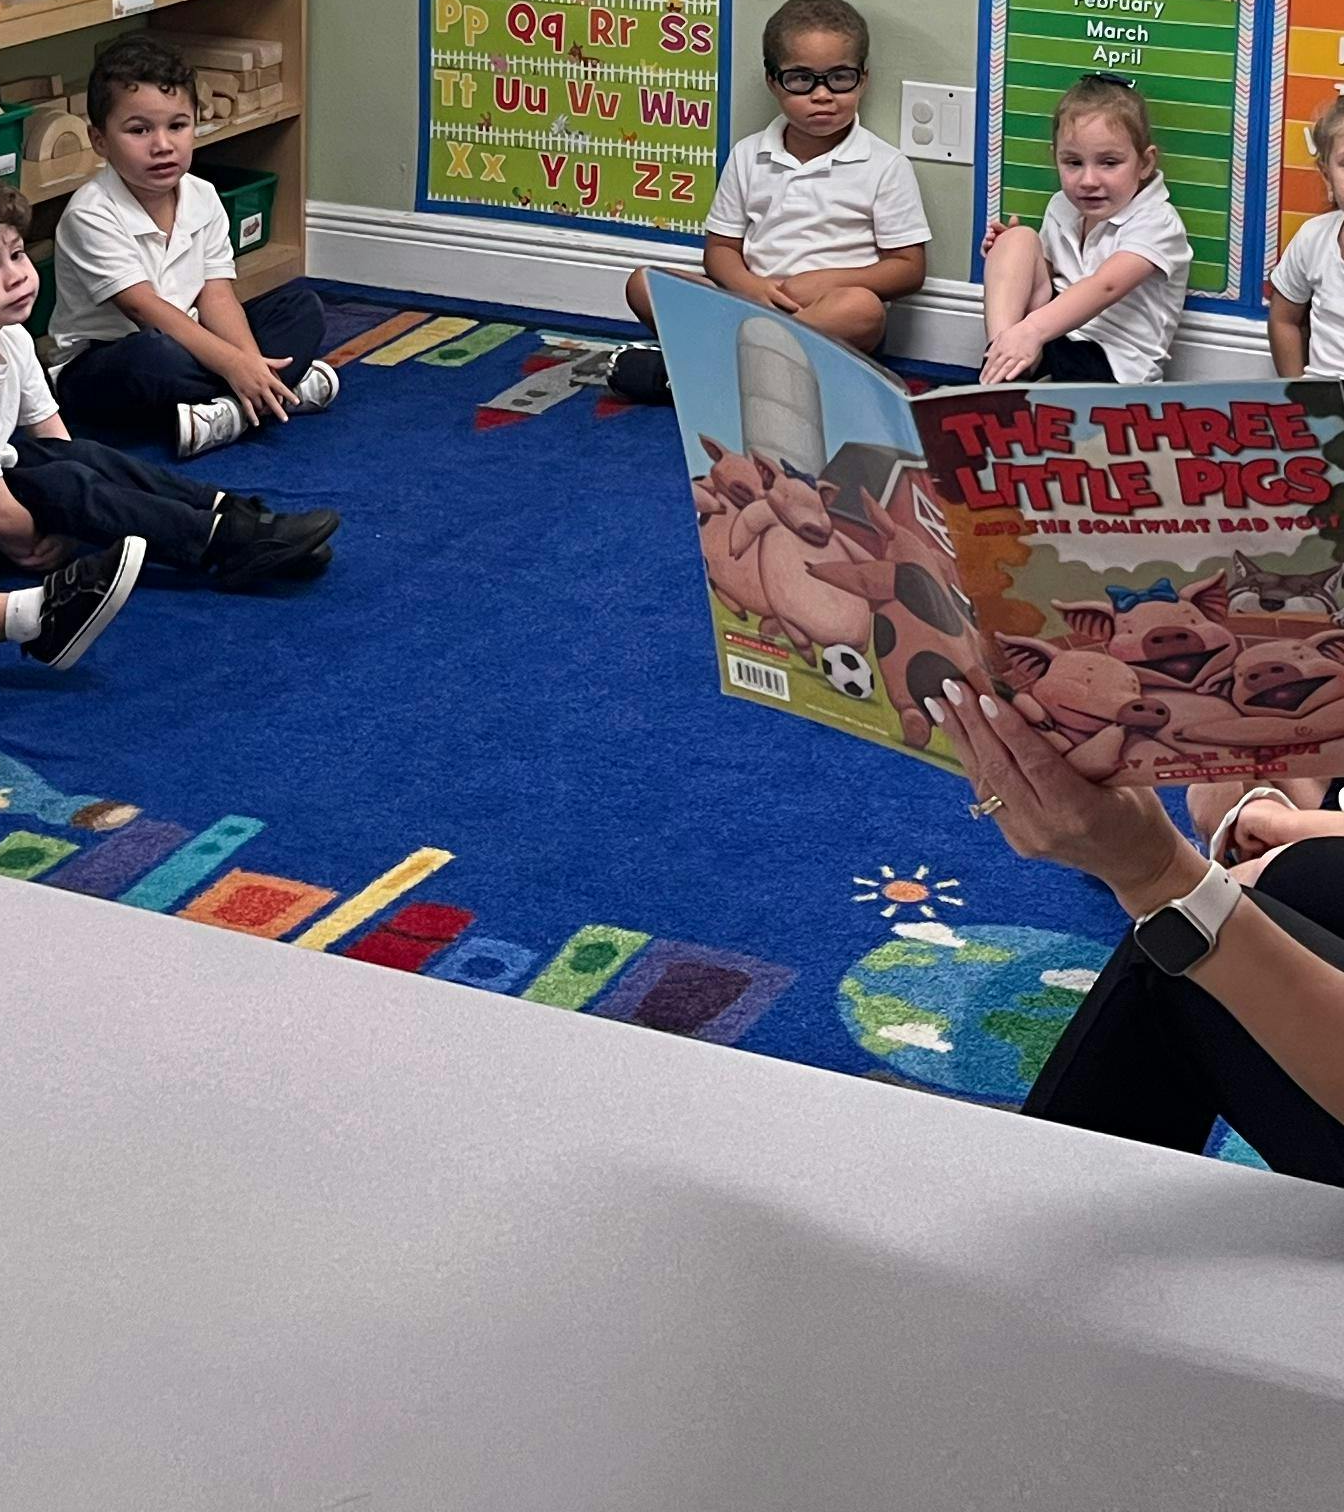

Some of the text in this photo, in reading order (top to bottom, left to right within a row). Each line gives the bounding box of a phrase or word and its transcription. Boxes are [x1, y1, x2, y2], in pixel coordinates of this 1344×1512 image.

[507, 2, 565, 53] Qq
[588, 8, 637, 46] Rr
[659, 13, 712, 54] Ss
[1087, 20, 1149, 43] March
[1093, 44, 1142, 67] April
[434, 70, 710, 128] Tt Uu Vv Ww
[447, 142, 695, 206] Xx Yy Zz
[942, 401, 1320, 459] THE THREE
[956, 457, 1332, 515] LITTLE PIGS
[974, 521, 1021, 536] AND
[1024, 519, 1072, 534] THE
[1078, 518, 1211, 534] SOMEWHAT
[1218, 517, 1269, 533] BAD
[1174, 762, 1286, 777] SCHOLASTIC
